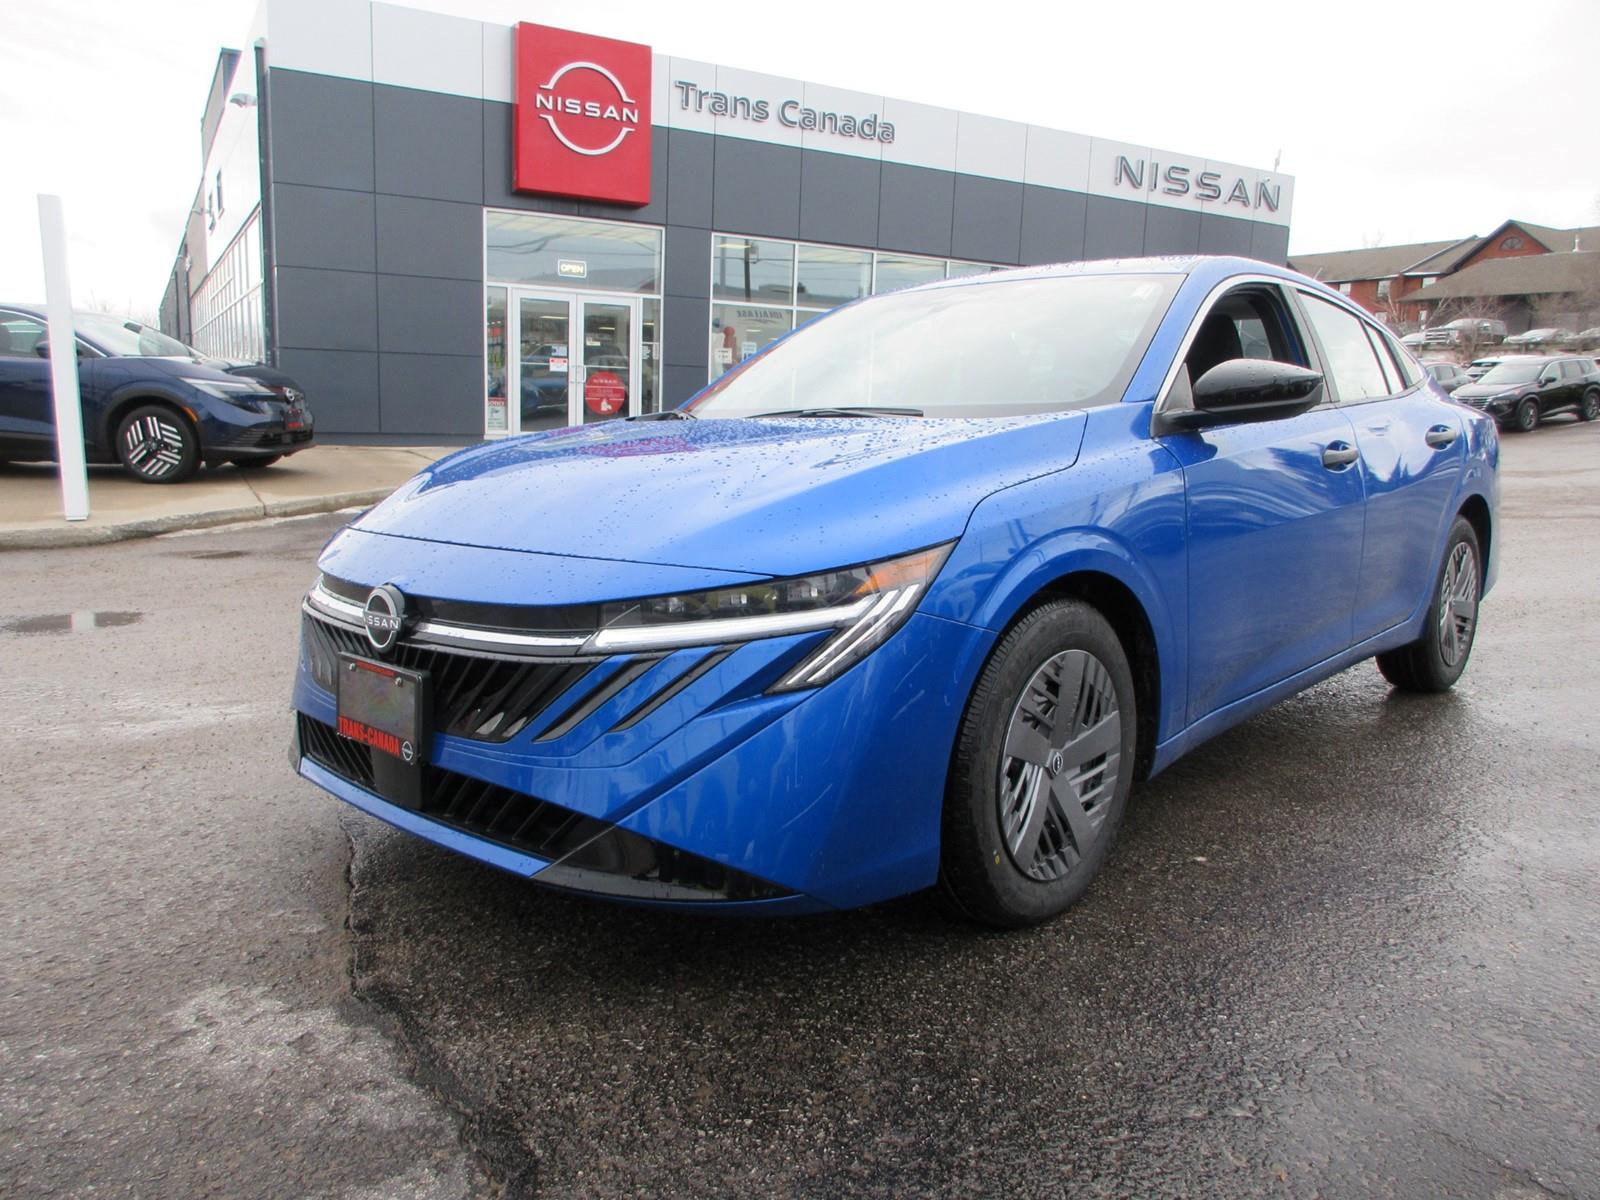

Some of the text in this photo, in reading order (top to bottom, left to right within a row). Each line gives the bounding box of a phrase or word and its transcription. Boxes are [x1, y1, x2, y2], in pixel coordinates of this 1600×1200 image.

[535, 93, 639, 124] NISSAN
[675, 80, 896, 144] Trans Canada
[1114, 155, 1281, 213] NISSAN
[560, 263, 584, 274] OPEN
[364, 615, 399, 629] SSAN
